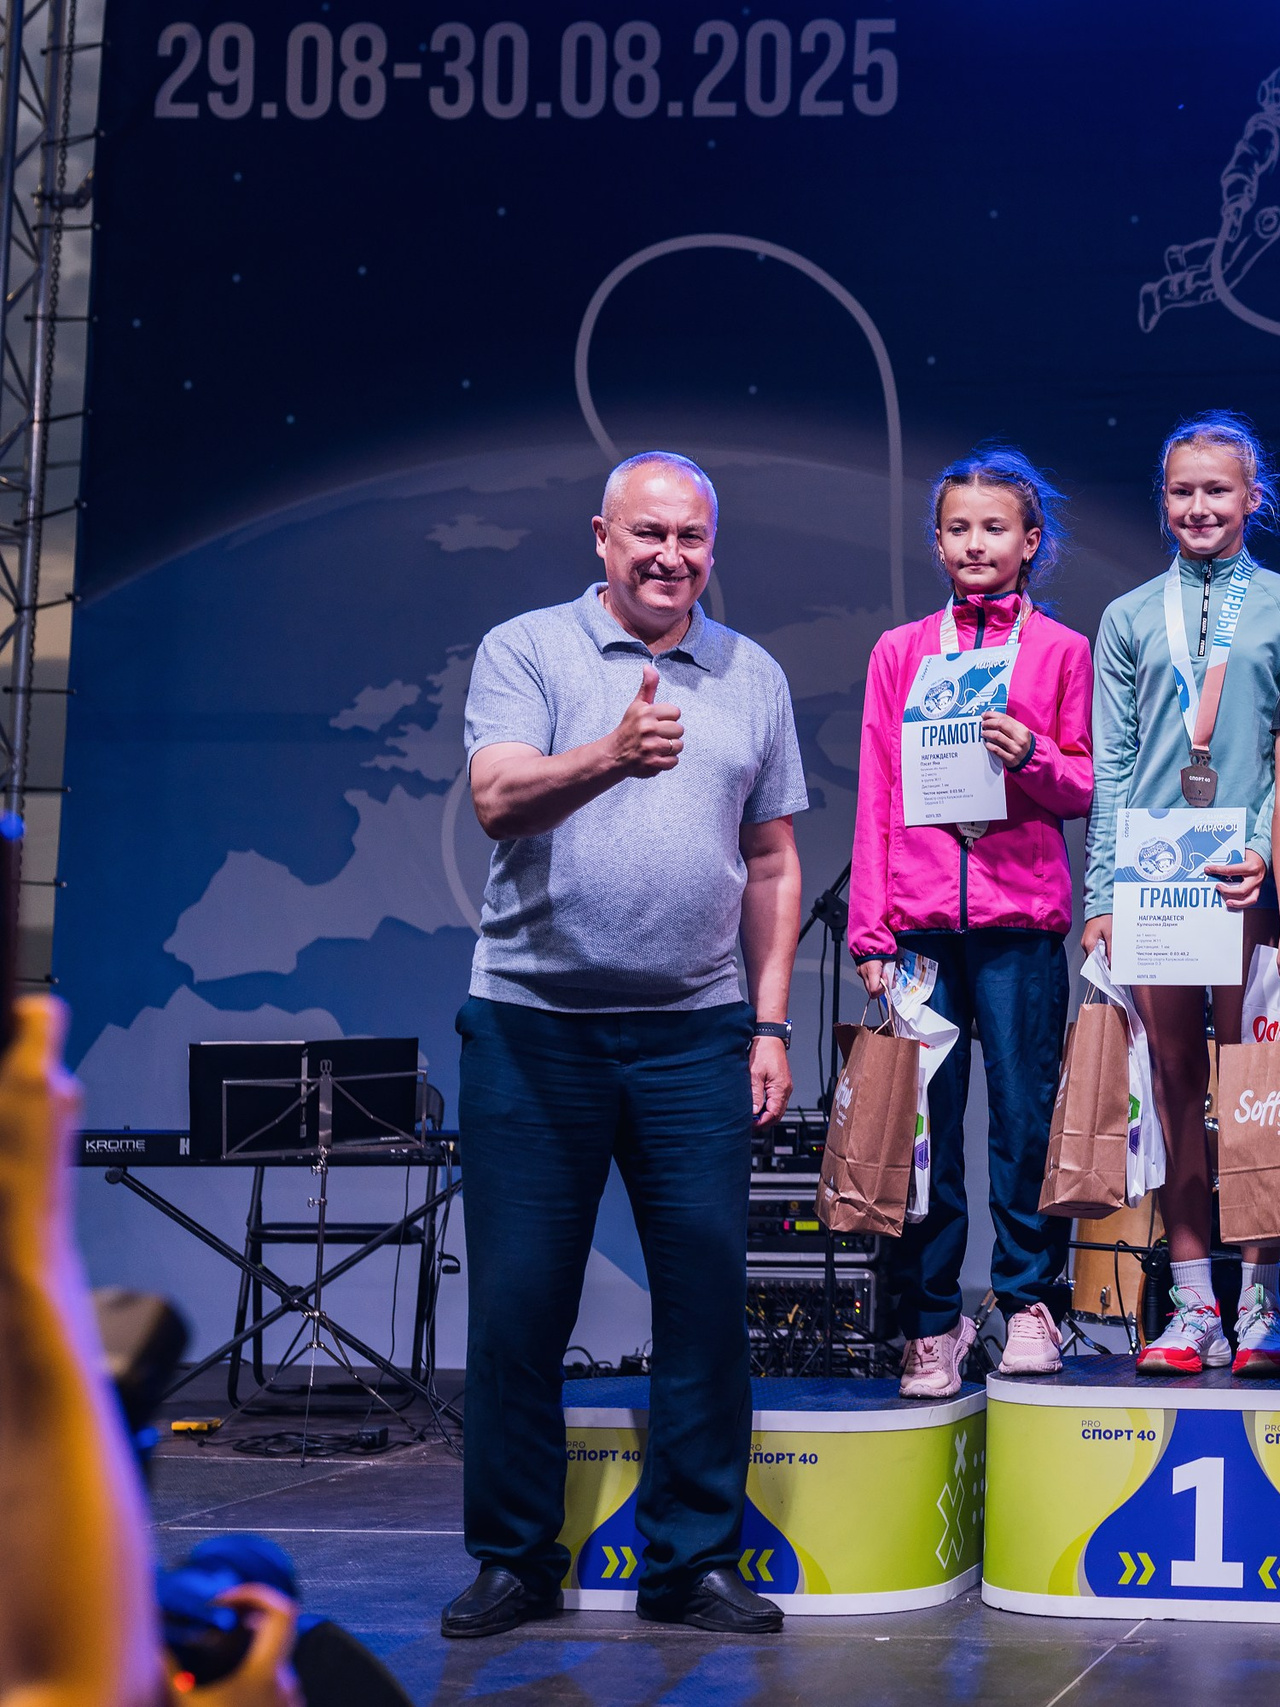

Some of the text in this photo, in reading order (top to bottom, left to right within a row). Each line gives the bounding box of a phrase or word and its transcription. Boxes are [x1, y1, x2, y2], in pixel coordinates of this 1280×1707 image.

[154, 18, 899, 120] 29.08-30.08.2025
[1213, 583, 1247, 648] ПЕРВЫМ
[921, 752, 958, 760] НАГРАЖДАЕТСЯ
[1139, 887, 1223, 908] ГРАМОТА
[85, 1139, 146, 1150] KROME
[1081, 1420, 1101, 1428] PRO
[1081, 1428, 1156, 1442] СПОРТ 40
[566, 1441, 586, 1449] PRO
[566, 1449, 641, 1462] СПОРТ 40
[798, 1453, 819, 1465] 40
[1170, 1456, 1244, 1589] 1
